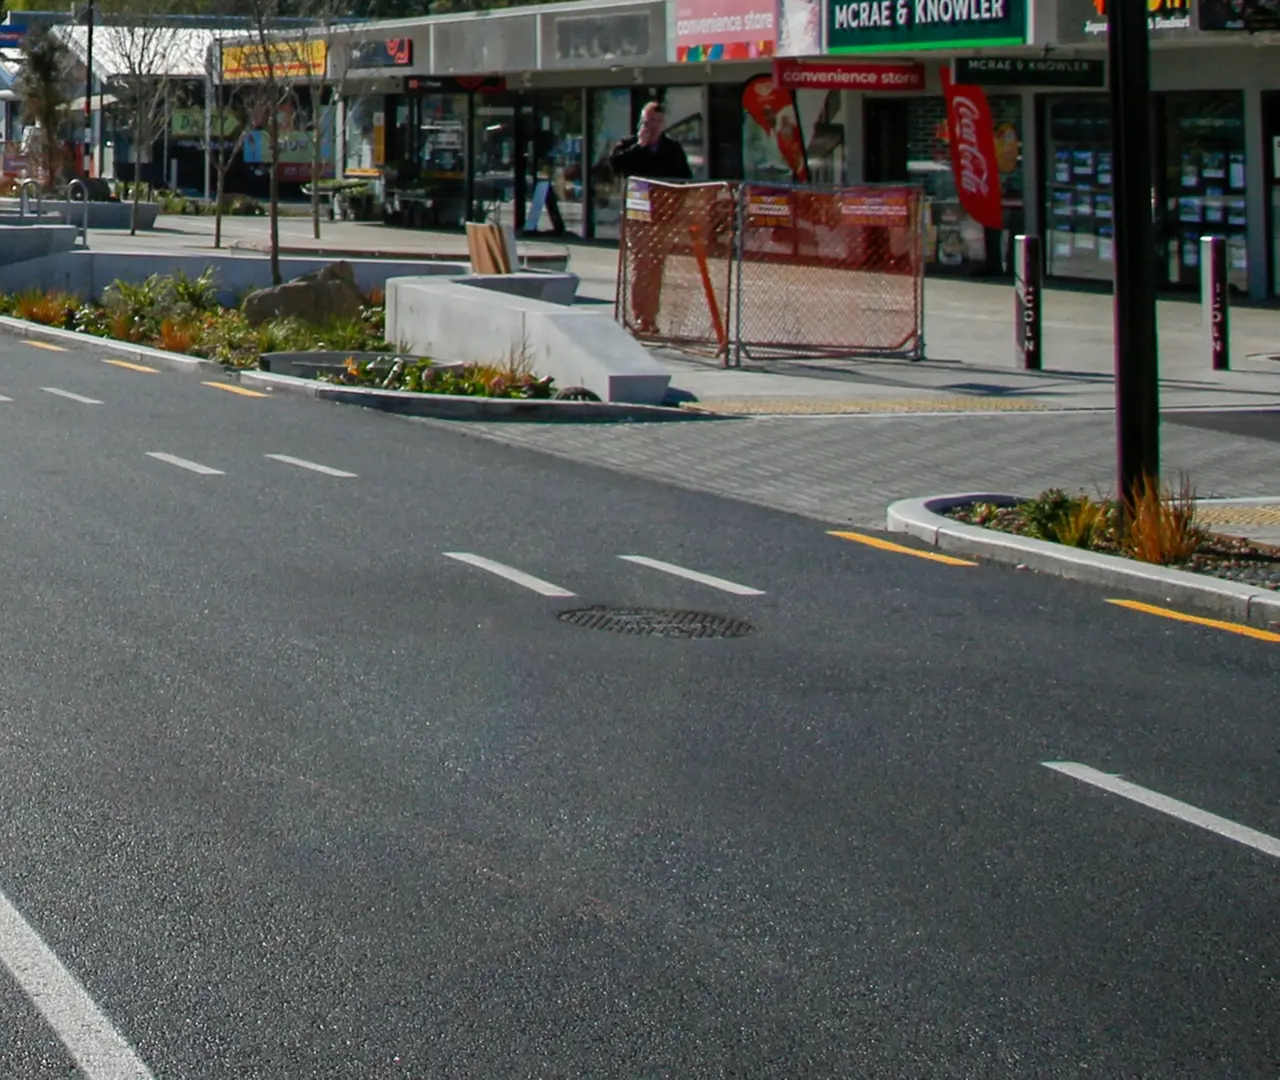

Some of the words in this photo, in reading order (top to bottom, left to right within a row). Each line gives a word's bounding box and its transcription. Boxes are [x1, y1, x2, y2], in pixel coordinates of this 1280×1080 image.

[677, 12, 741, 36] convenience
[744, 10, 773, 31] store
[834, 0, 891, 29] MCRAE
[896, 0, 908, 24] &
[782, 68, 878, 83] convenience
[881, 71, 920, 84] store
[968, 59, 1012, 71] MCRAE
[1028, 61, 1090, 72] KNOWLER
